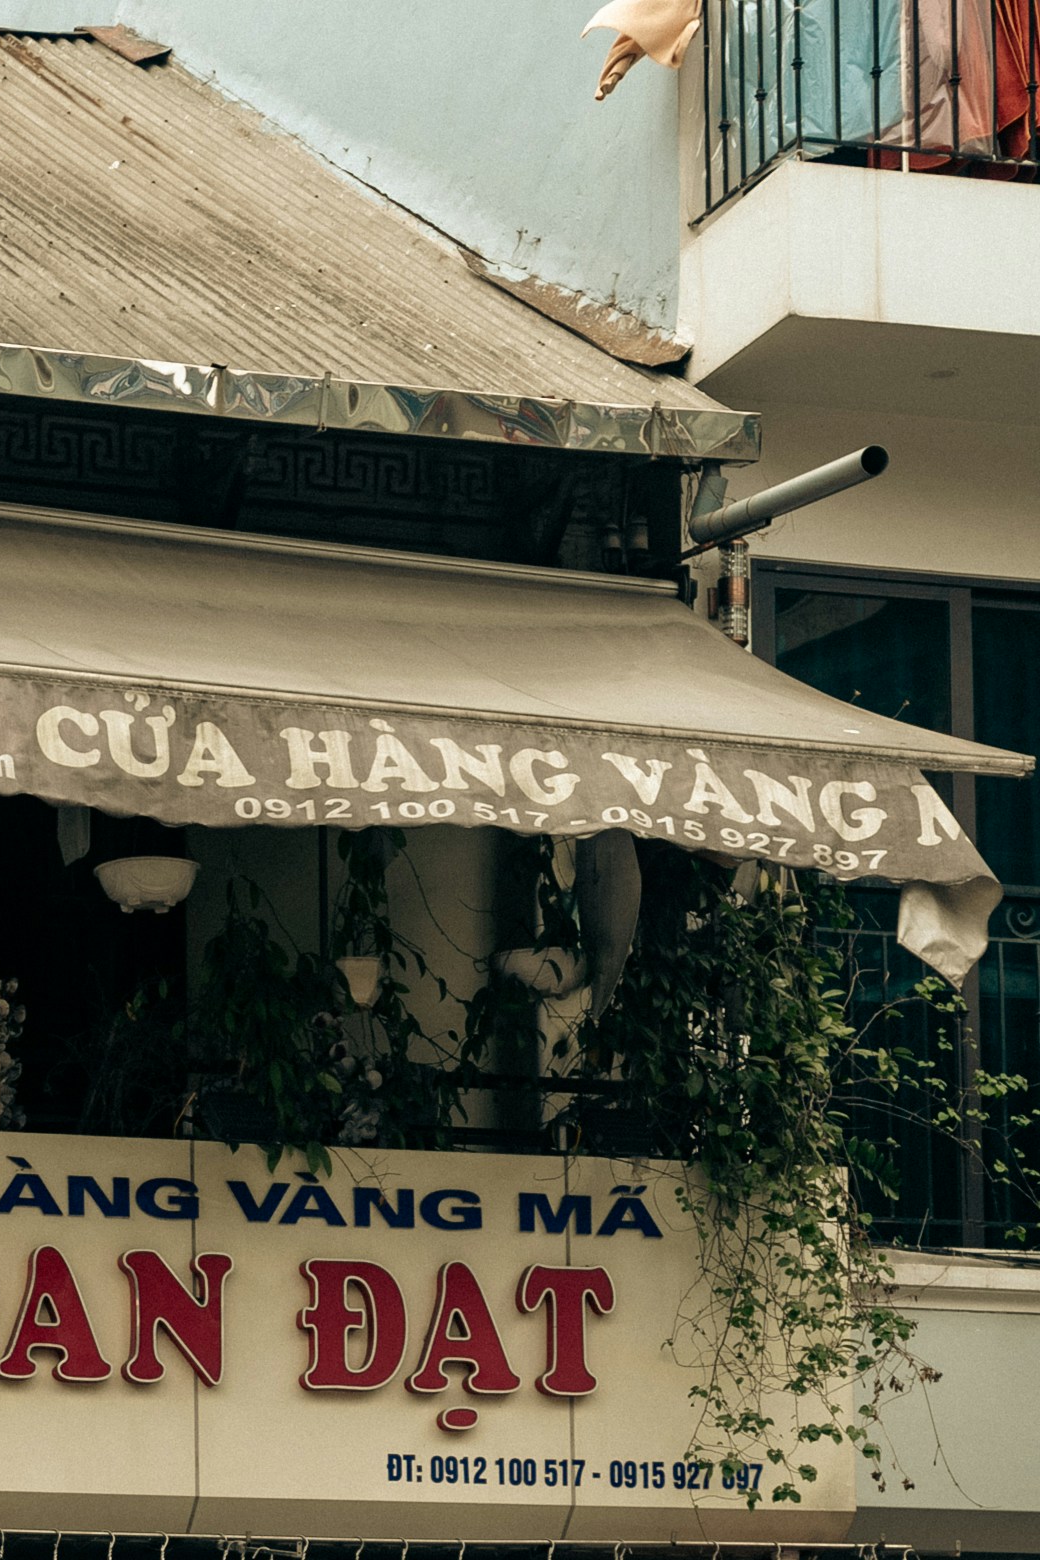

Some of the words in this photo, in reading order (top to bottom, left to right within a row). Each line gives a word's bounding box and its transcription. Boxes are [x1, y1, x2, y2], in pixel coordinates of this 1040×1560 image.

[36, 691, 256, 789] CỬA
[279, 718, 581, 804] HÀNG
[601, 747, 888, 842] VÀNG
[235, 797, 353, 821] 0912
[370, 798, 456, 821] 100
[472, 802, 549, 828] 517
[601, 804, 706, 844] 0915
[721, 826, 794, 859] 927
[812, 842, 888, 871] 897
[227, 1171, 484, 1231] VÀNG
[518, 1184, 664, 1239] MÃ
[296, 1257, 617, 1433] ĐẠT
[386, 1453, 424, 1483] ĐT:
[429, 1455, 488, 1485] 0912
[494, 1457, 538, 1486] 100
[543, 1458, 586, 1487] 517
[609, 1460, 666, 1489] 0915
